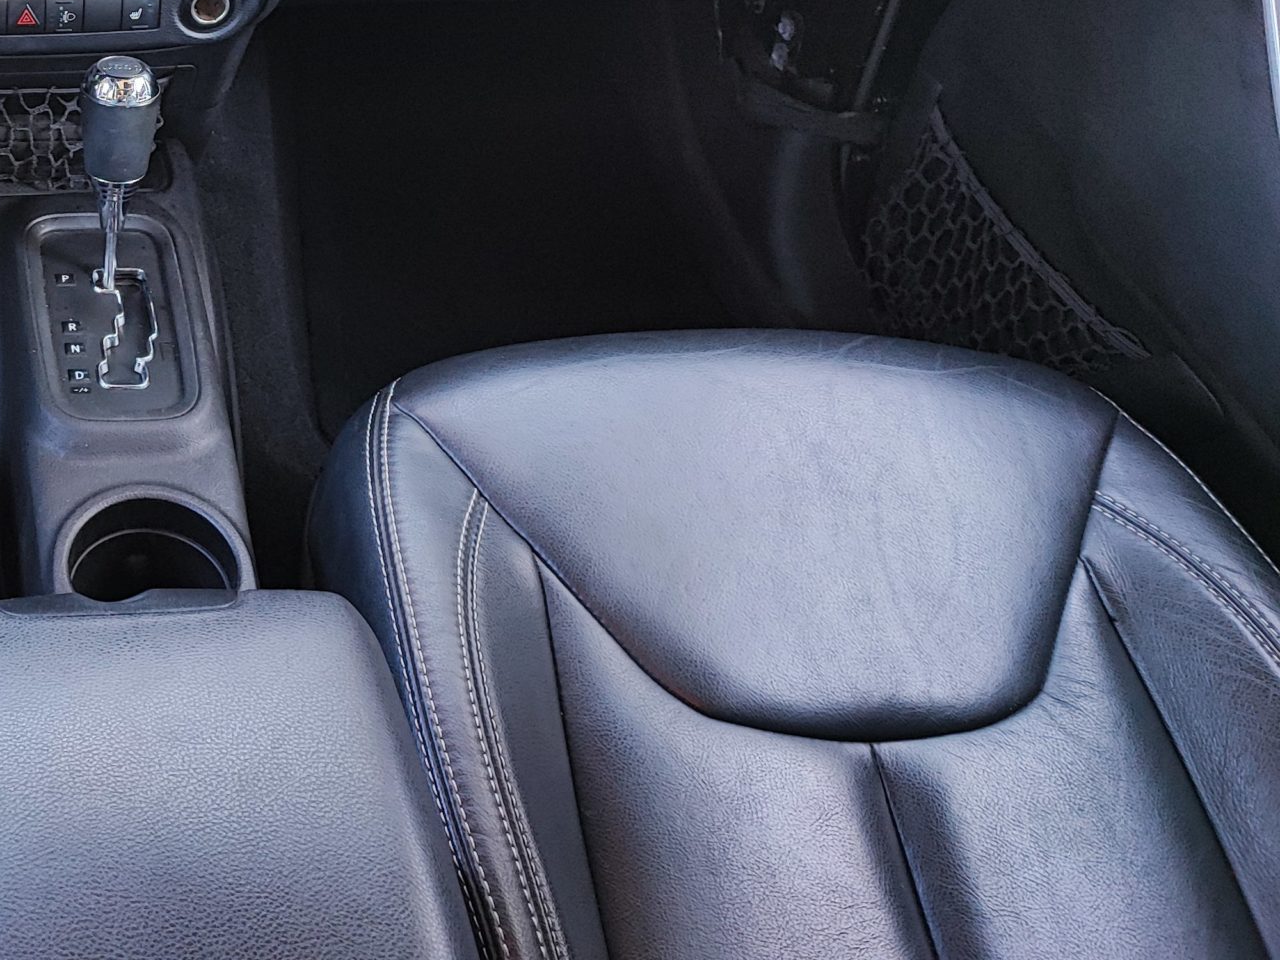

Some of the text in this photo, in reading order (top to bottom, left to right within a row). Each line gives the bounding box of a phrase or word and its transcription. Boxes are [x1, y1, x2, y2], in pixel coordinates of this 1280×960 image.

[61, 274, 70, 283] P
[68, 322, 77, 331] R
[70, 344, 81, 354] N
[74, 370, 85, 380] D
